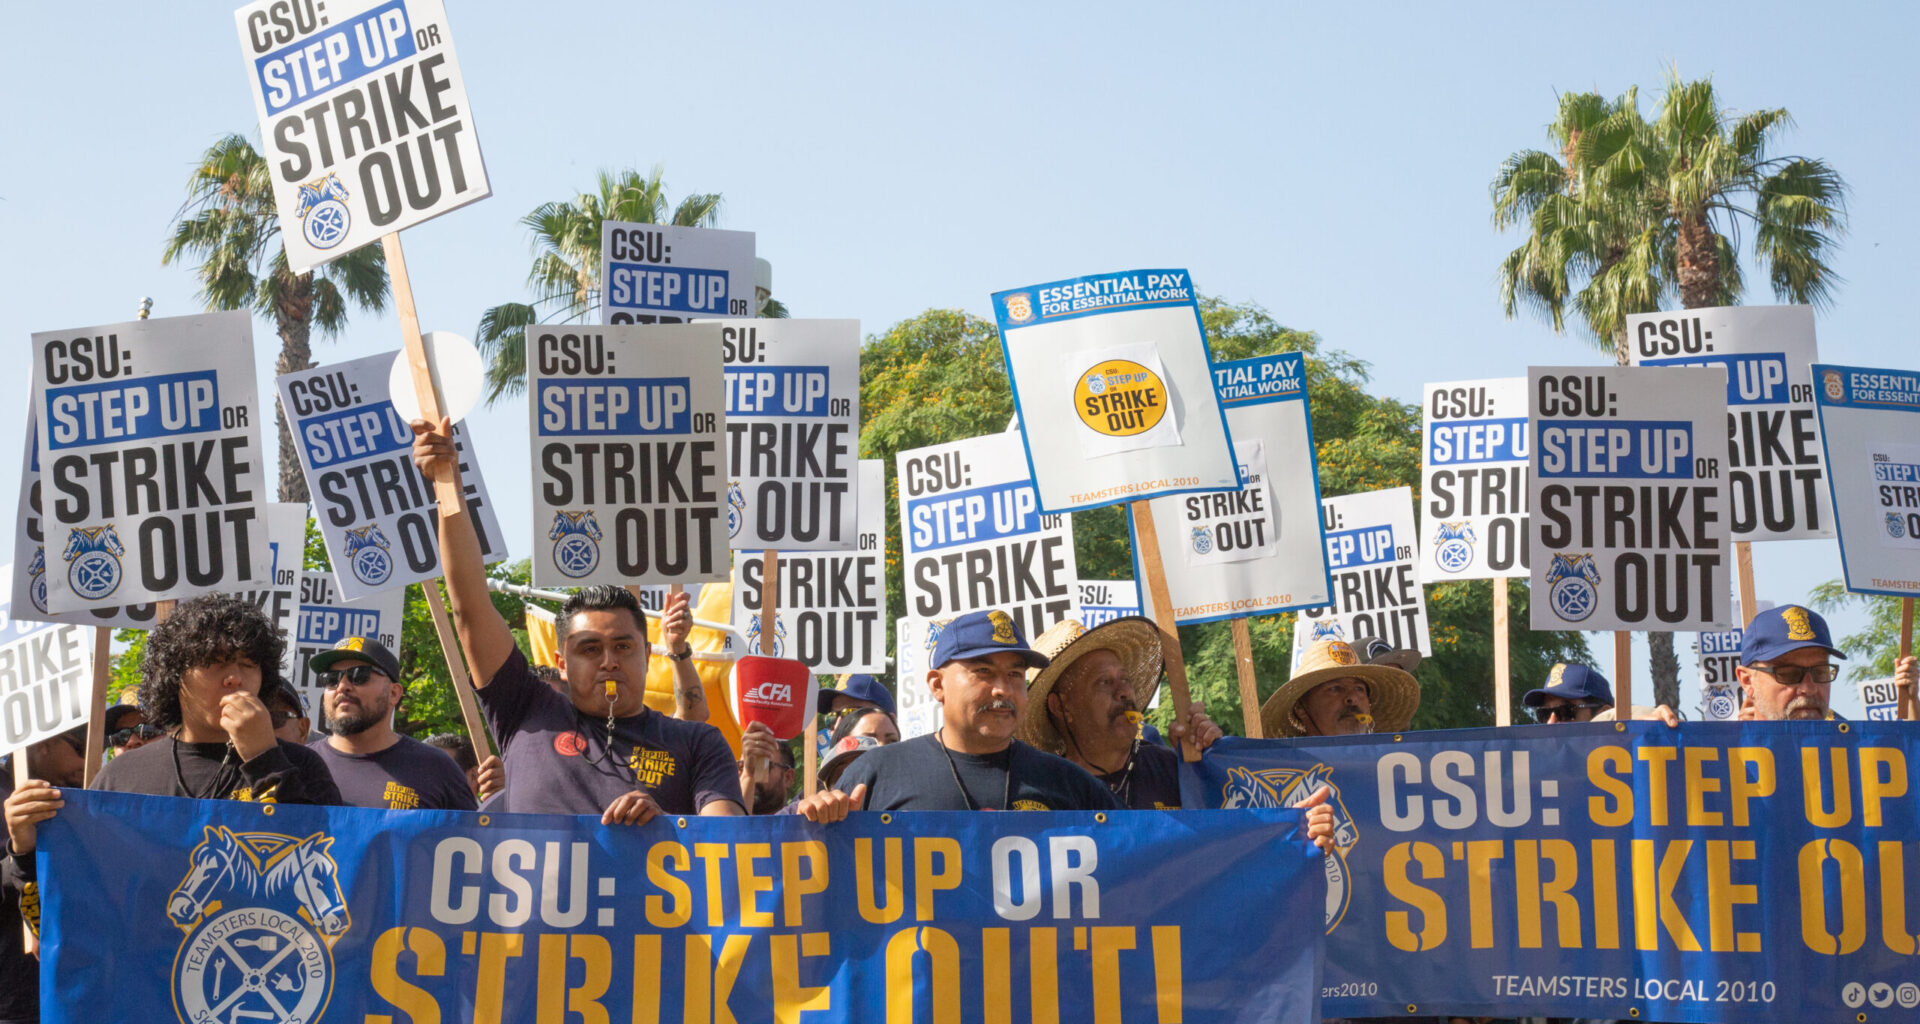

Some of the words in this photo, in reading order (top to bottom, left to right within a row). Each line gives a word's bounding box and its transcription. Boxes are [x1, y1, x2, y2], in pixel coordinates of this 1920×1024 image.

[247, 0, 329, 53] CSU:
[264, 32, 350, 108] STEP
[355, 8, 407, 68] UP
[416, 24, 441, 51] OR
[273, 53, 458, 183] STRIKE
[358, 120, 468, 227] OUT
[611, 228, 671, 263] CSU:
[613, 268, 681, 306] STEP
[688, 274, 726, 310] UP
[730, 299, 748, 315] OR
[1039, 276, 1144, 304] ESSENTIAL
[1148, 274, 1184, 289] PAY
[1042, 302, 1070, 315] FOR
[1073, 291, 1143, 310] ESSENTIAL
[1145, 288, 1189, 300] WORK
[538, 334, 615, 376] CSU:
[722, 327, 765, 363] SU:
[1638, 317, 1714, 357] CSU:
[44, 334, 132, 384] CSU:
[1107, 374, 1132, 386] STEP
[1134, 372, 1148, 383] UP
[1261, 360, 1298, 378] PAY
[289, 372, 361, 416] CSU:
[724, 372, 776, 412] TEP
[783, 372, 825, 412] UP
[831, 398, 850, 417] OR
[1085, 388, 1158, 416] STRIKE
[1259, 377, 1300, 394] WORK
[1538, 376, 1617, 417] CSU:
[1737, 360, 1783, 400] UP
[1791, 384, 1812, 403] OR
[1851, 373, 1920, 392] ESSENTI
[1852, 389, 1876, 401] FOR
[1879, 391, 1920, 404] ESSENT
[53, 387, 149, 443] STEP
[159, 379, 214, 430] UP
[222, 406, 248, 429] OR
[543, 386, 629, 431] STEP
[638, 385, 686, 430] UP
[693, 413, 716, 433] OR
[1107, 409, 1144, 432] OUT
[1432, 387, 1494, 419] CSU:
[306, 411, 383, 464] STEP
[386, 407, 415, 445] U
[727, 423, 848, 478] TRIKE
[1434, 423, 1504, 462] STEP
[1511, 423, 1528, 457] U
[1543, 427, 1630, 473] STEP
[1640, 428, 1689, 474] UP
[1696, 458, 1719, 478] OR
[1728, 410, 1818, 467] RIKE
[53, 436, 253, 523] STRIKE
[541, 441, 717, 506] STRIKE
[906, 450, 972, 497] CSU:
[1070, 483, 1133, 504] TEAMSTERS
[1136, 479, 1171, 493] LOCAL
[1173, 476, 1200, 488] 2010
[1250, 475, 1260, 483] OR
[1430, 466, 1529, 519] STRI
[1874, 464, 1912, 481] STEP
[757, 481, 848, 542] OUT
[1186, 488, 1263, 521] STRIKE
[1540, 484, 1719, 549] STRIKE
[1730, 469, 1822, 533] OUT
[1879, 485, 1920, 507] STRI
[912, 495, 986, 549] STEP
[992, 487, 1036, 533] UP
[1043, 513, 1062, 530] OR
[1216, 518, 1265, 552] OUT
[138, 507, 256, 592] OUT
[615, 507, 718, 577] OUT
[859, 533, 877, 550] OR
[1360, 529, 1392, 562] UP
[1396, 545, 1411, 560] OR
[277, 569, 295, 586] OR
[300, 577, 333, 604] SU:
[914, 536, 1068, 618] STRIKE
[1614, 552, 1720, 623] OUT
[298, 610, 340, 640] TEP
[344, 613, 377, 640] UP
[1172, 602, 1230, 617] TEAMSTERS
[1232, 597, 1264, 610] LOCAL
[1266, 594, 1292, 605] 2010
[0, 624, 82, 696] RIKE
[797, 611, 878, 668] OUT
[1703, 632, 1741, 653] STEP
[4, 667, 83, 744] OUT
[758, 682, 791, 702] CFA
[1864, 683, 1898, 704] CSU
[630, 755, 676, 776] STRIKE
[637, 769, 664, 786] OUT
[383, 790, 420, 808] STRIKE
[1377, 750, 1560, 832] CSU:
[1587, 745, 1777, 827] STEP
[1801, 746, 1909, 828] UP
[430, 837, 615, 928] CSU:
[645, 840, 829, 928] STEP
[854, 836, 963, 924] UP
[991, 835, 1100, 921] OR
[1383, 839, 1762, 952] STRIKE
[1797, 838, 1920, 956] OU
[186, 912, 256, 974] TEAMSTERS
[260, 913, 301, 945] LOCAL
[301, 942, 323, 980] 2010
[364, 926, 830, 1024] STRIKE
[1492, 975, 1628, 998] TEAMSTERS
[1634, 978, 1710, 1002] LOCAL
[1716, 980, 1777, 1002] 2010
